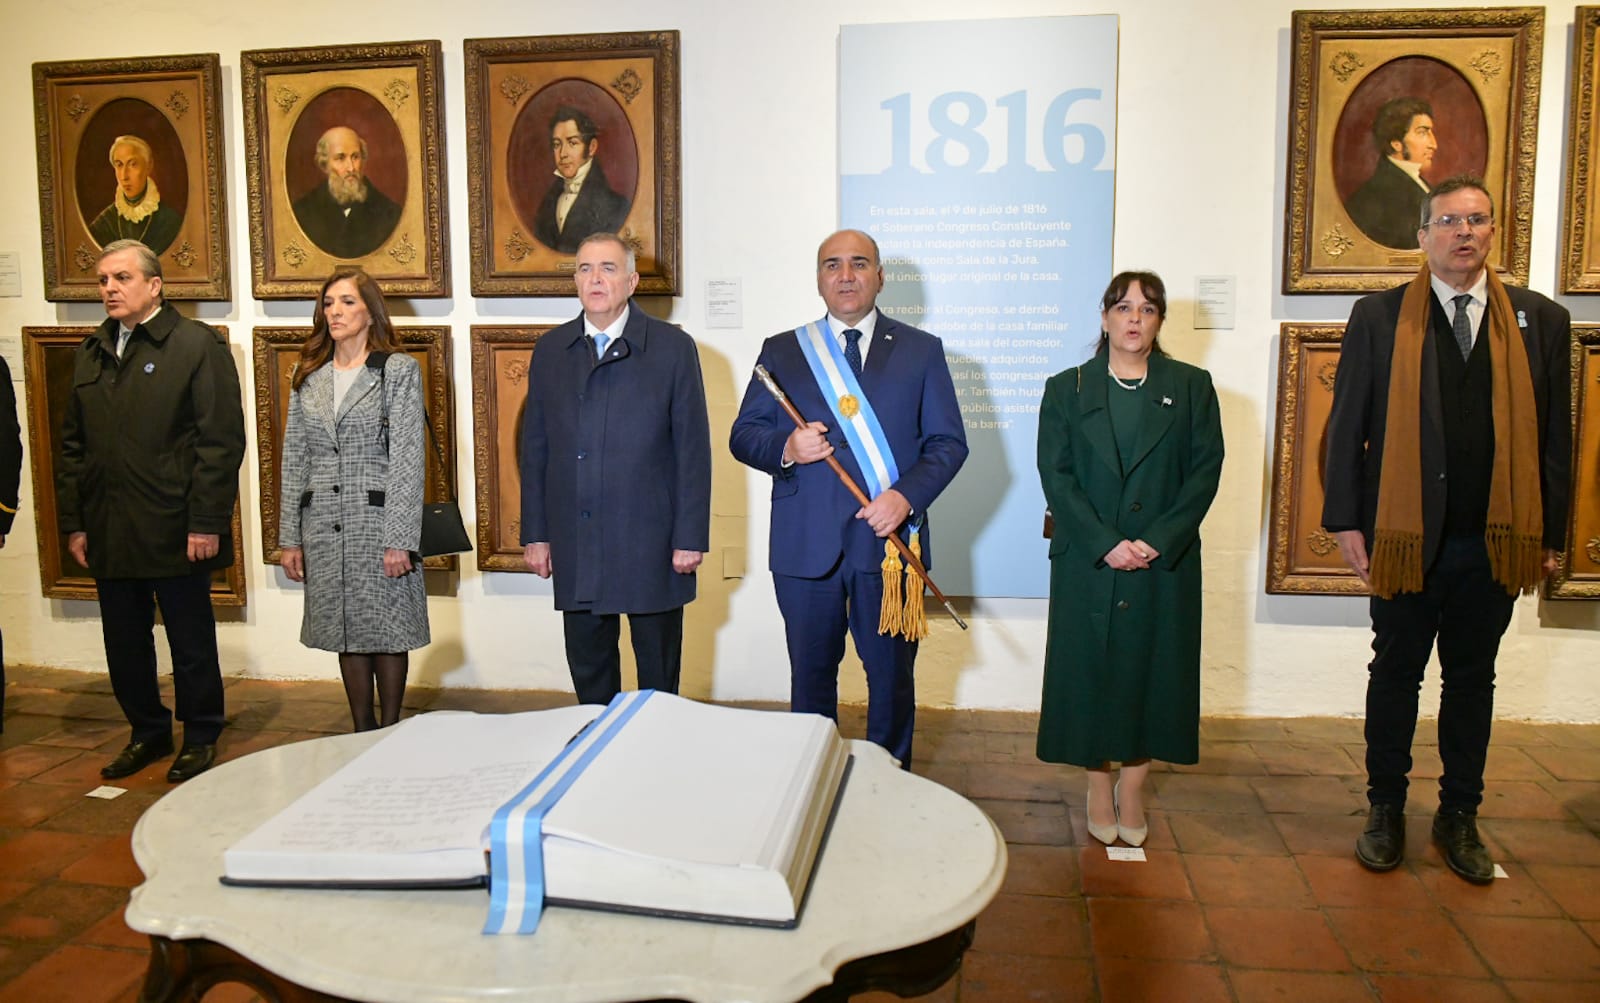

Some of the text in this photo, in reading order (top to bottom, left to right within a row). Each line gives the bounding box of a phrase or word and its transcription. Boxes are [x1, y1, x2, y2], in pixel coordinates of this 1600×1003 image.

[880, 87, 1106, 174] 1816
[870, 206, 884, 216] En
[886, 206, 911, 216] esta
[941, 206, 951, 216] el
[952, 206, 960, 215] 9
[963, 205, 977, 215] de
[979, 204, 1003, 217] julio
[1005, 204, 1020, 214] de
[1022, 203, 1048, 214] 1816
[869, 220, 1073, 235] el Soberano Congreso Constituyente
[877, 238, 911, 249] eclaró
[912, 239, 922, 249] la
[1008, 238, 1023, 248] de
[1025, 235, 1071, 249] España.
[924, 254, 953, 265] como
[955, 254, 980, 265] Sala
[983, 254, 996, 265] de
[998, 254, 1009, 264] la
[1010, 253, 1041, 265] Jura.
[885, 271, 1063, 285] el único lugar original de la casa.
[896, 304, 929, 315] recibir
[1003, 304, 1017, 314] se
[1019, 303, 1060, 315] derribó
[931, 320, 968, 331] adobe
[969, 320, 984, 332] de
[985, 320, 996, 331] la
[998, 321, 1025, 331] casa
[1027, 320, 1069, 332] familiar
[967, 338, 990, 348] sala
[992, 337, 1010, 348] del
[1012, 337, 1064, 348] comedor.
[990, 354, 1049, 367] adquiridos
[953, 369, 968, 380] así
[971, 369, 986, 380] los
[969, 385, 1016, 397] También
[961, 402, 1001, 415] público
